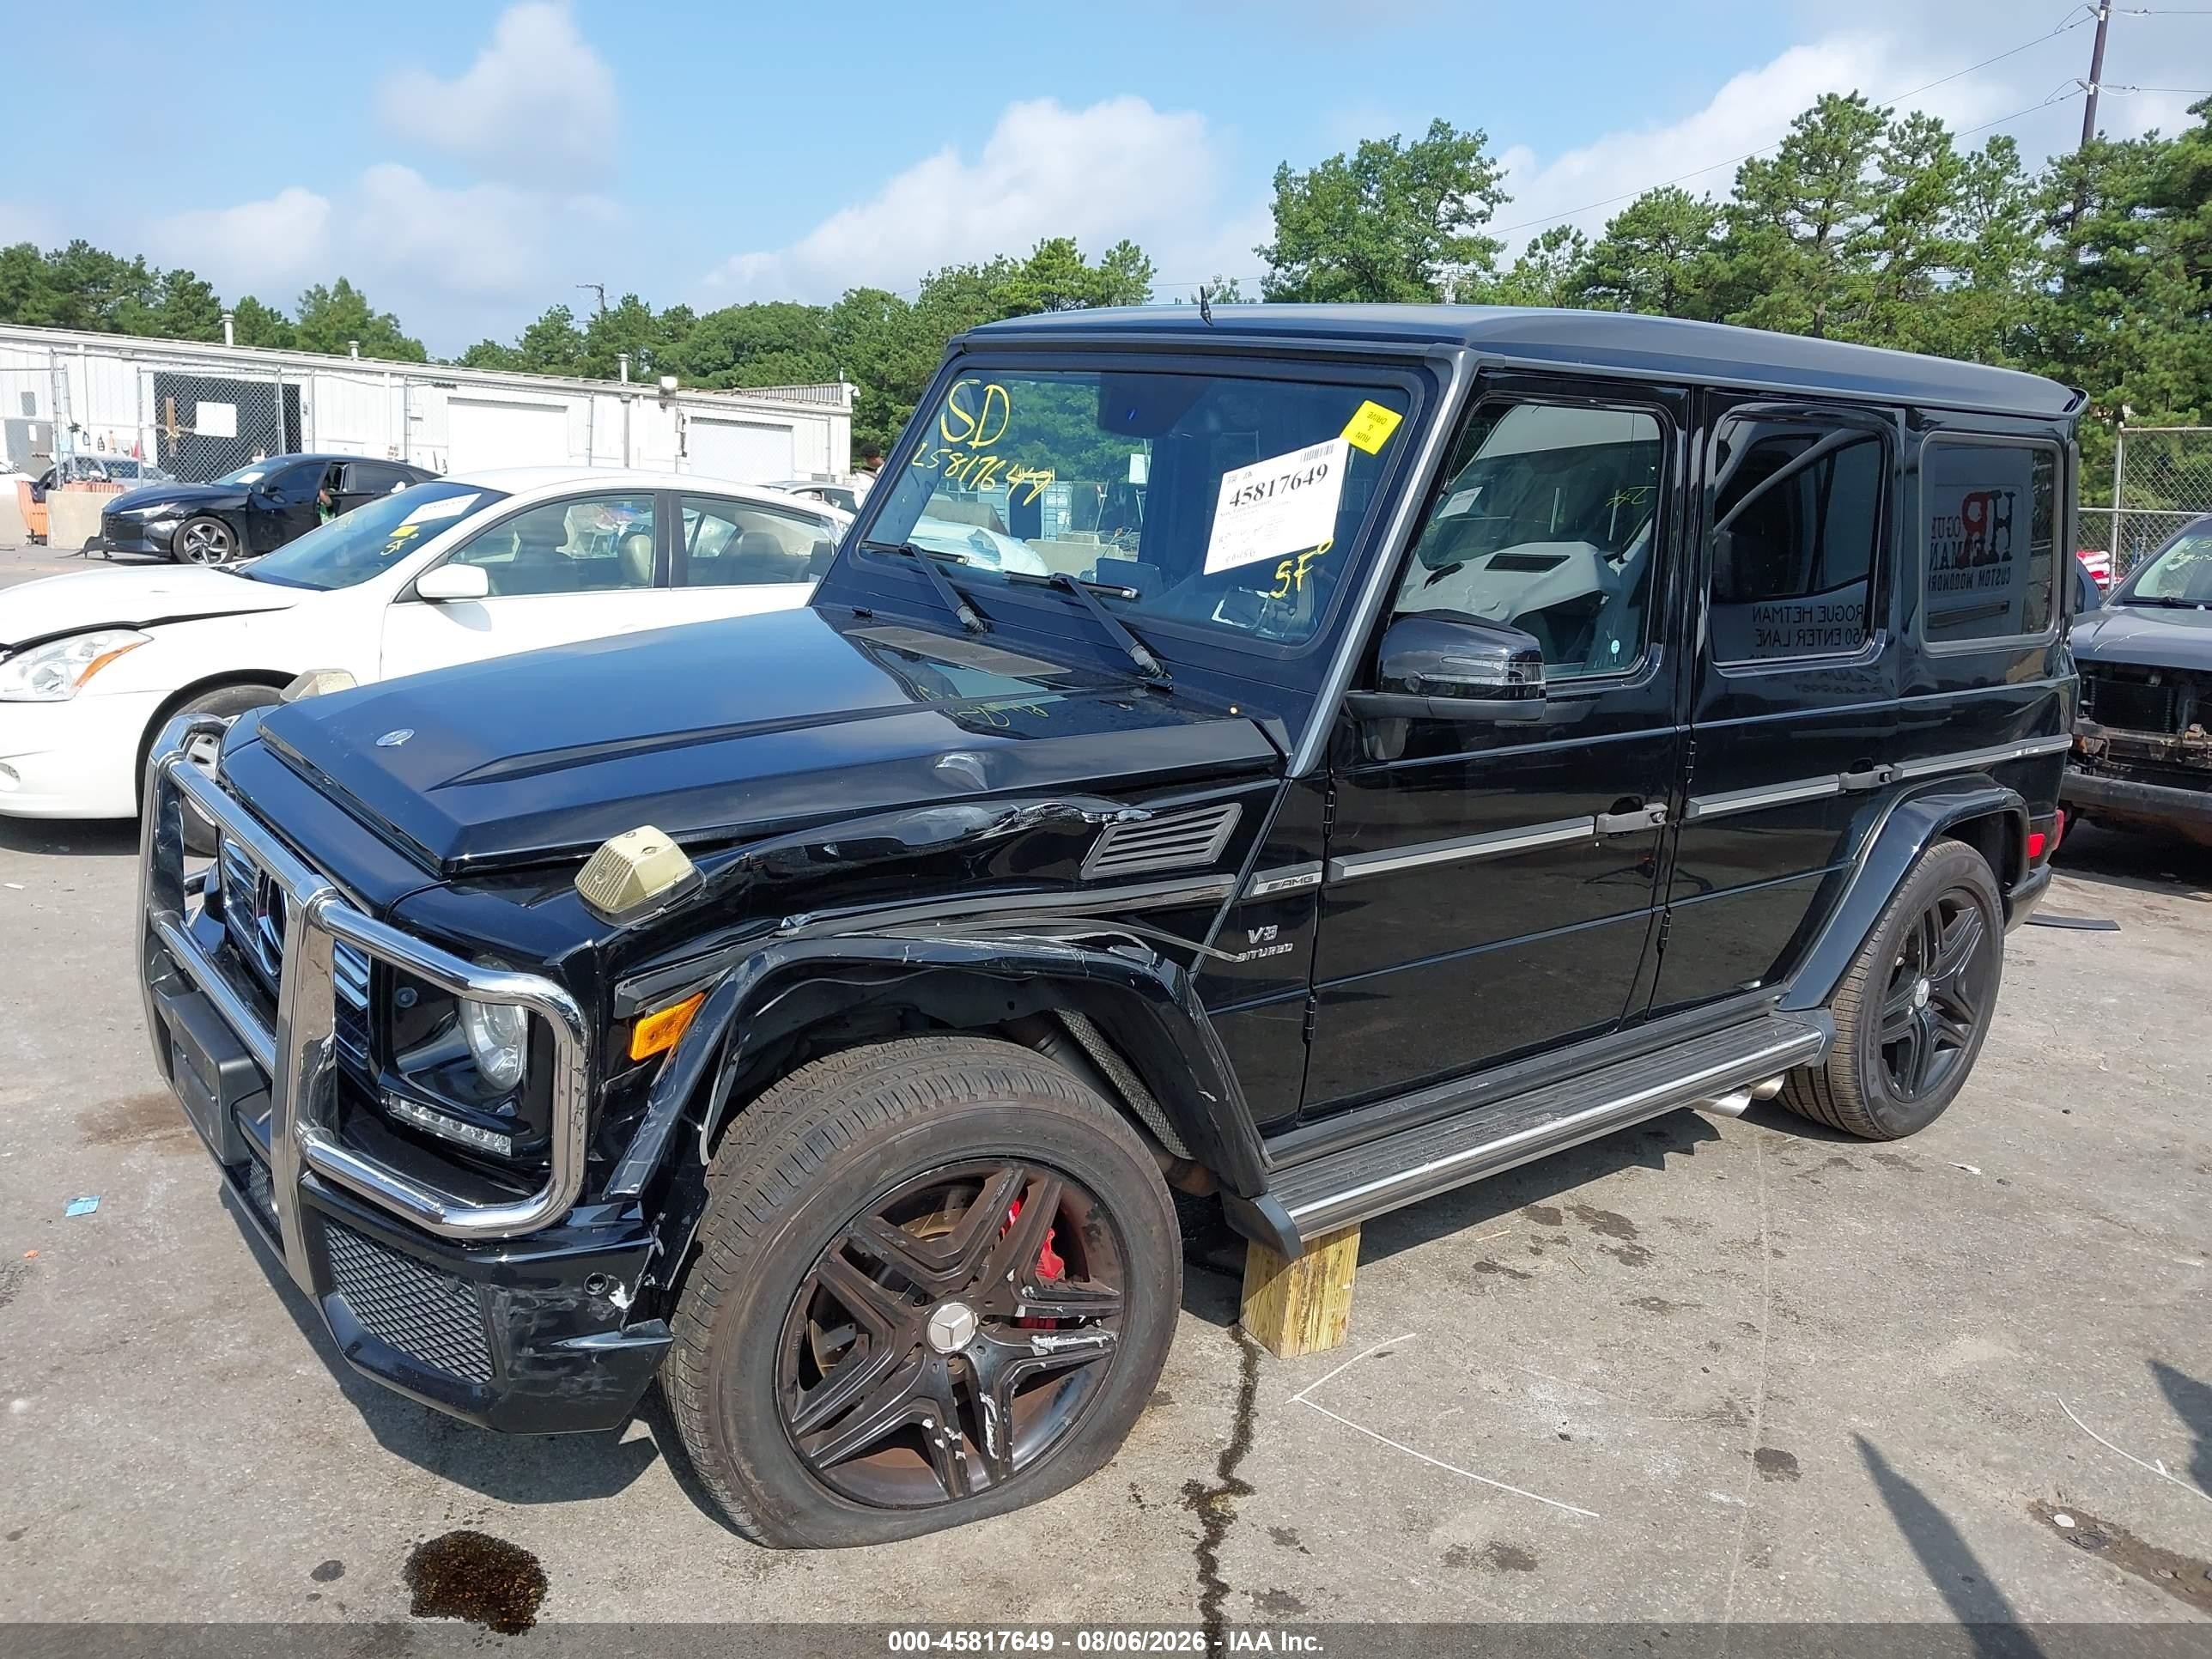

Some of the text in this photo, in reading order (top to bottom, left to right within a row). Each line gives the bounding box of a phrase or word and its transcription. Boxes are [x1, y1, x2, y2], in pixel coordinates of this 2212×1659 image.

[940, 379, 1010, 450] SD
[1366, 411, 1388, 425] DRIVE
[1355, 431, 1371, 444] RUN
[1229, 463, 1328, 507] 45817649
[1282, 875, 1315, 888] AMG
[1248, 925, 1278, 944] V8
